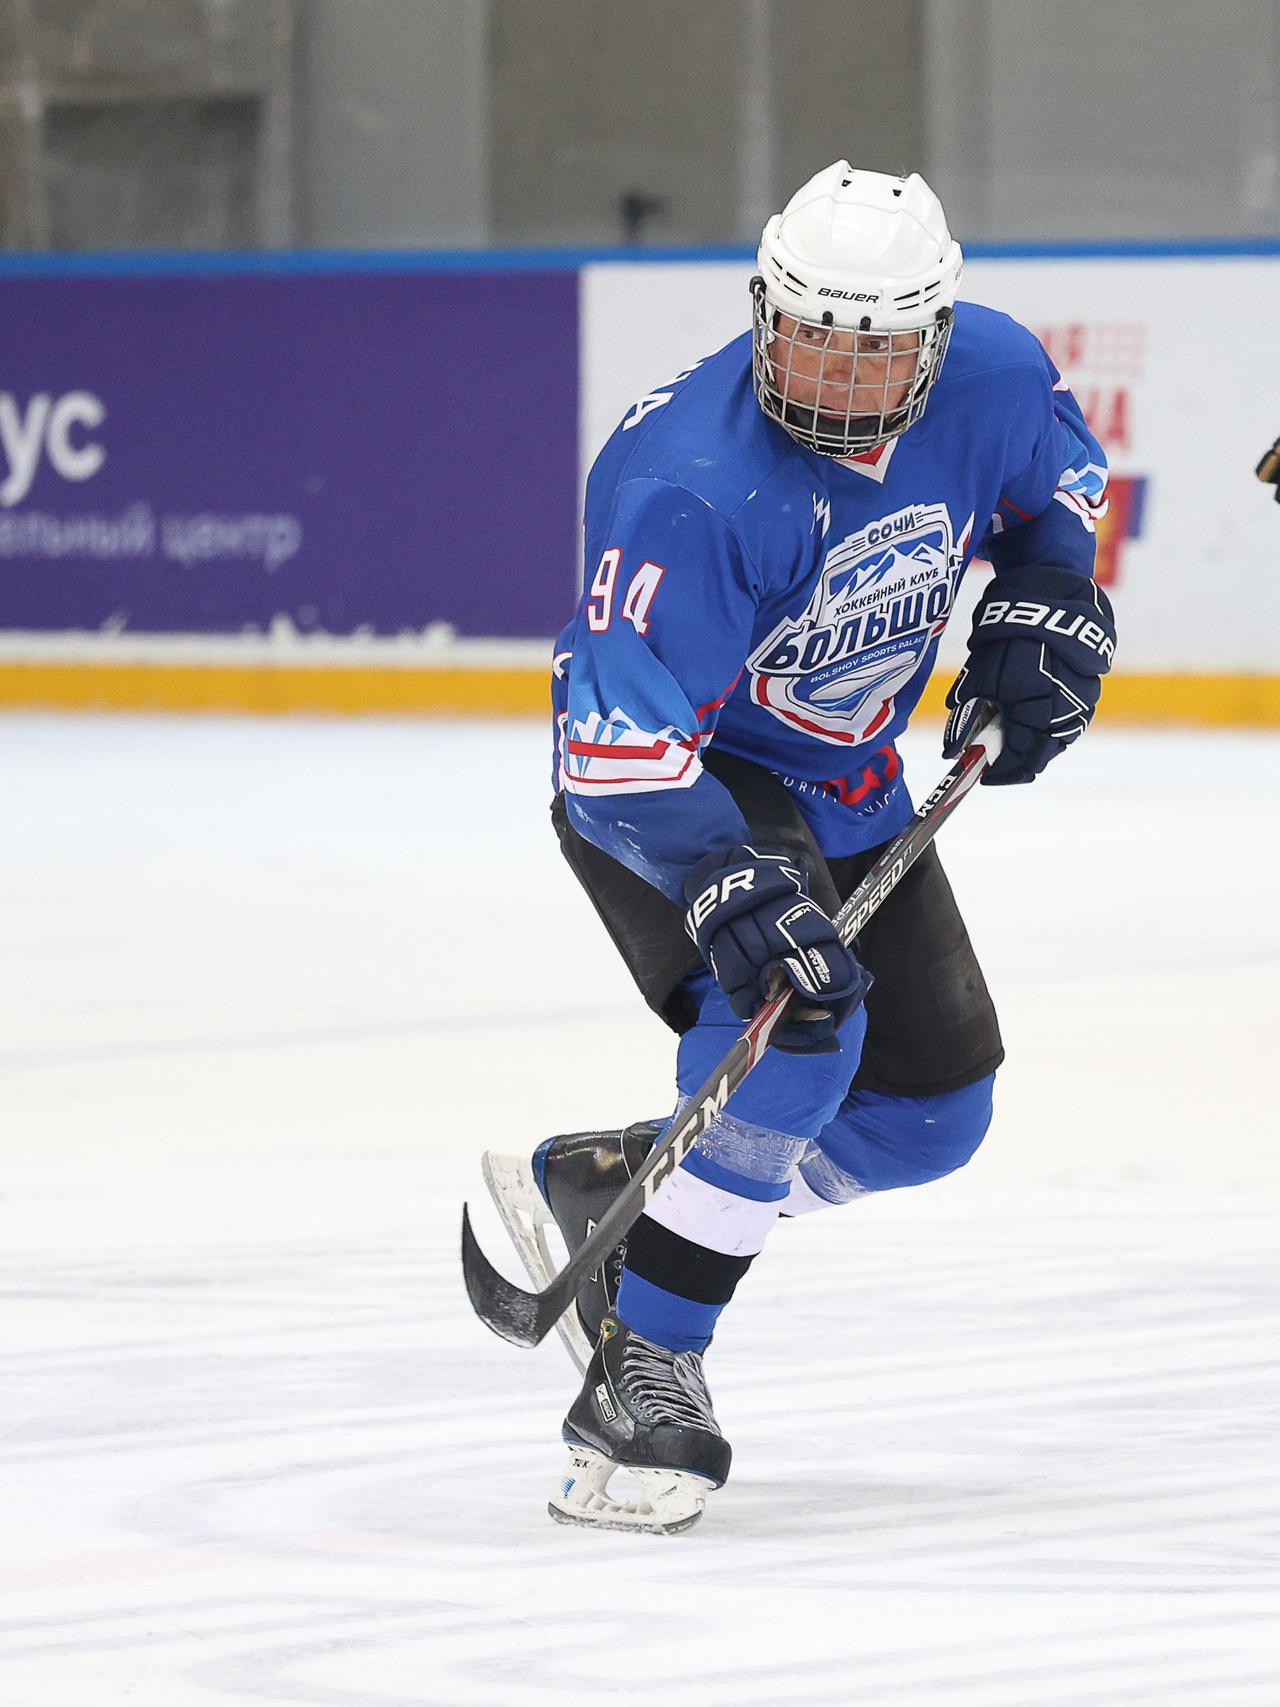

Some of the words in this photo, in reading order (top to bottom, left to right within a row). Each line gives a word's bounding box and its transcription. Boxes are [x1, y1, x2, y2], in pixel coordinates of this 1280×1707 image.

[868, 512, 916, 545] СОЧИ
[586, 547, 666, 636] 94
[758, 568, 962, 671] БОЛЬШО
[833, 577, 907, 618] ХОККЕЙНЫЙ
[910, 567, 940, 588] КЛУБ
[810, 660, 860, 683] BOLSHOY
[861, 644, 897, 662] SPORTS
[915, 774, 958, 818] CCM
[838, 858, 904, 949] SPEED
[640, 1073, 729, 1209] CCM
